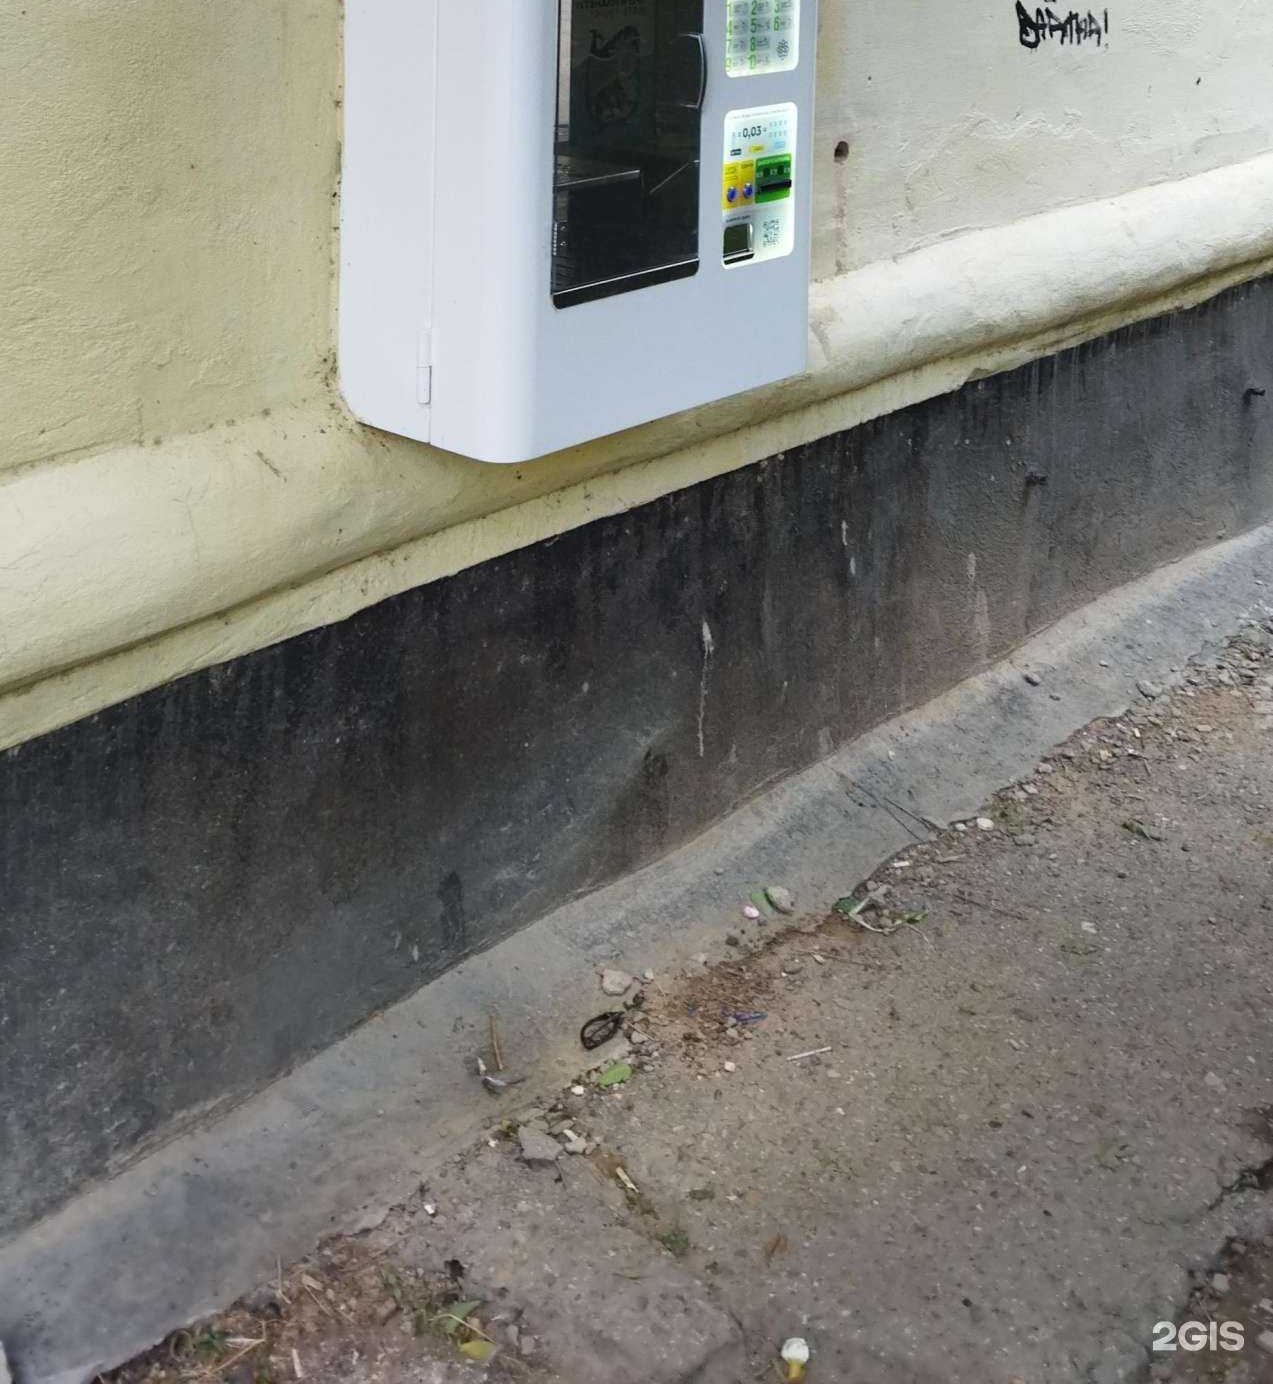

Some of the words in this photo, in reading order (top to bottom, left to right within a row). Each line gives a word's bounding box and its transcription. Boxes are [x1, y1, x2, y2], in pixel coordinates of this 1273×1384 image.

[751, 0, 758, 15] 2
[750, 18, 757, 33] 5
[742, 125, 762, 140] 0,03
